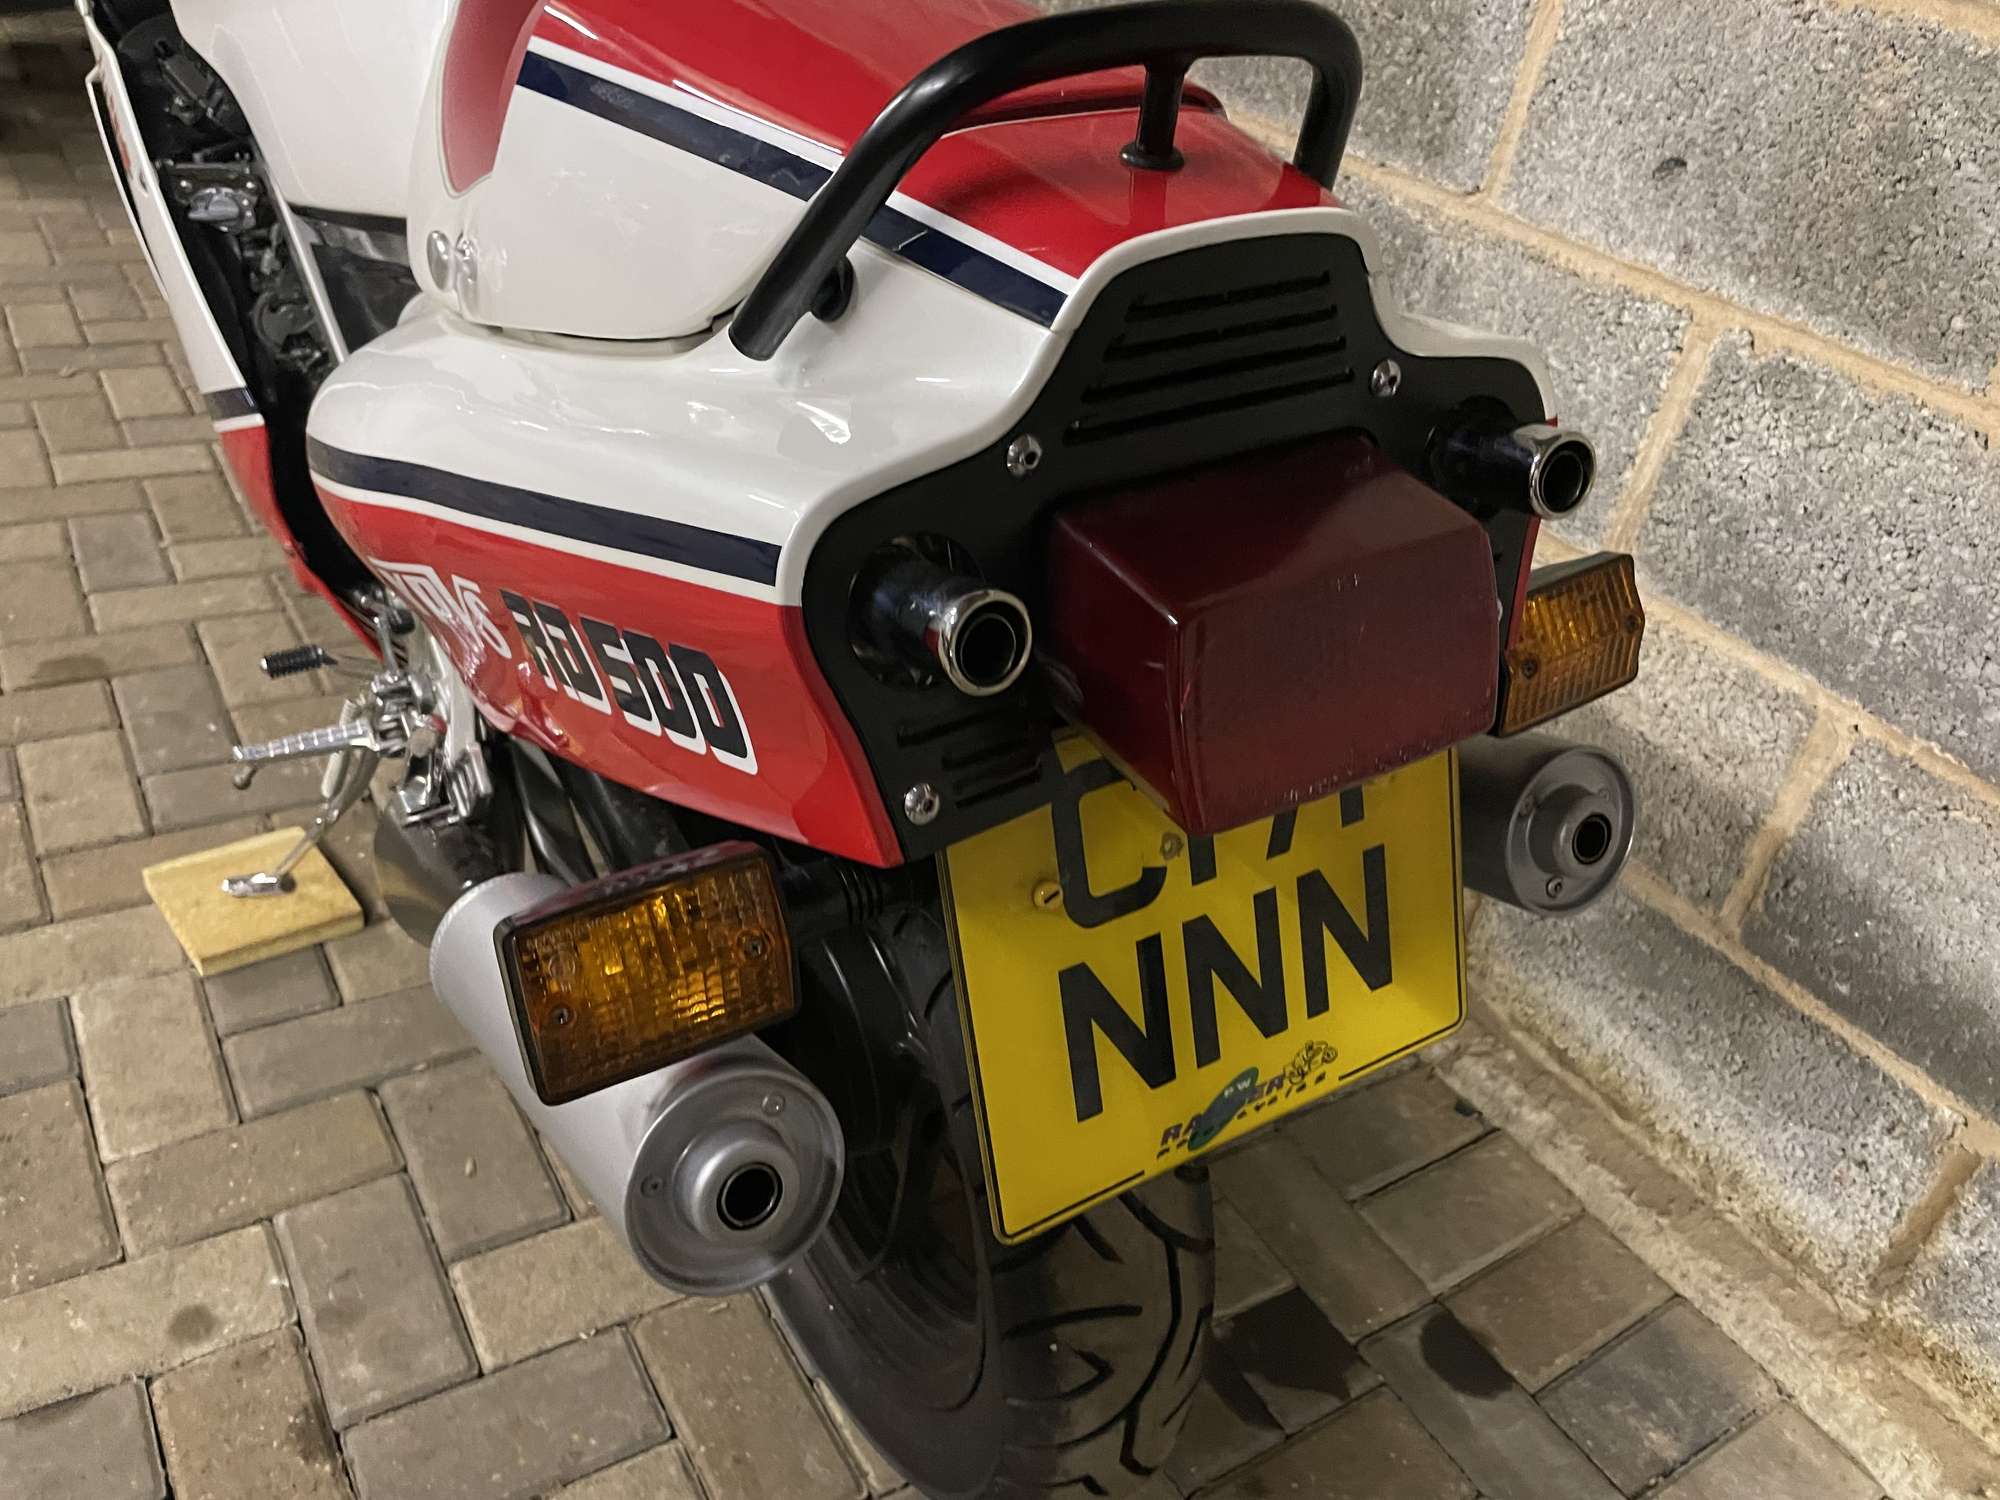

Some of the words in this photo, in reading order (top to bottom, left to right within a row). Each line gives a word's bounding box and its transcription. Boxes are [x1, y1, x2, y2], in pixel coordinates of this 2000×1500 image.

[500, 588, 612, 715] RD
[578, 613, 758, 775] 500
[1058, 843, 1392, 1123] NNN
